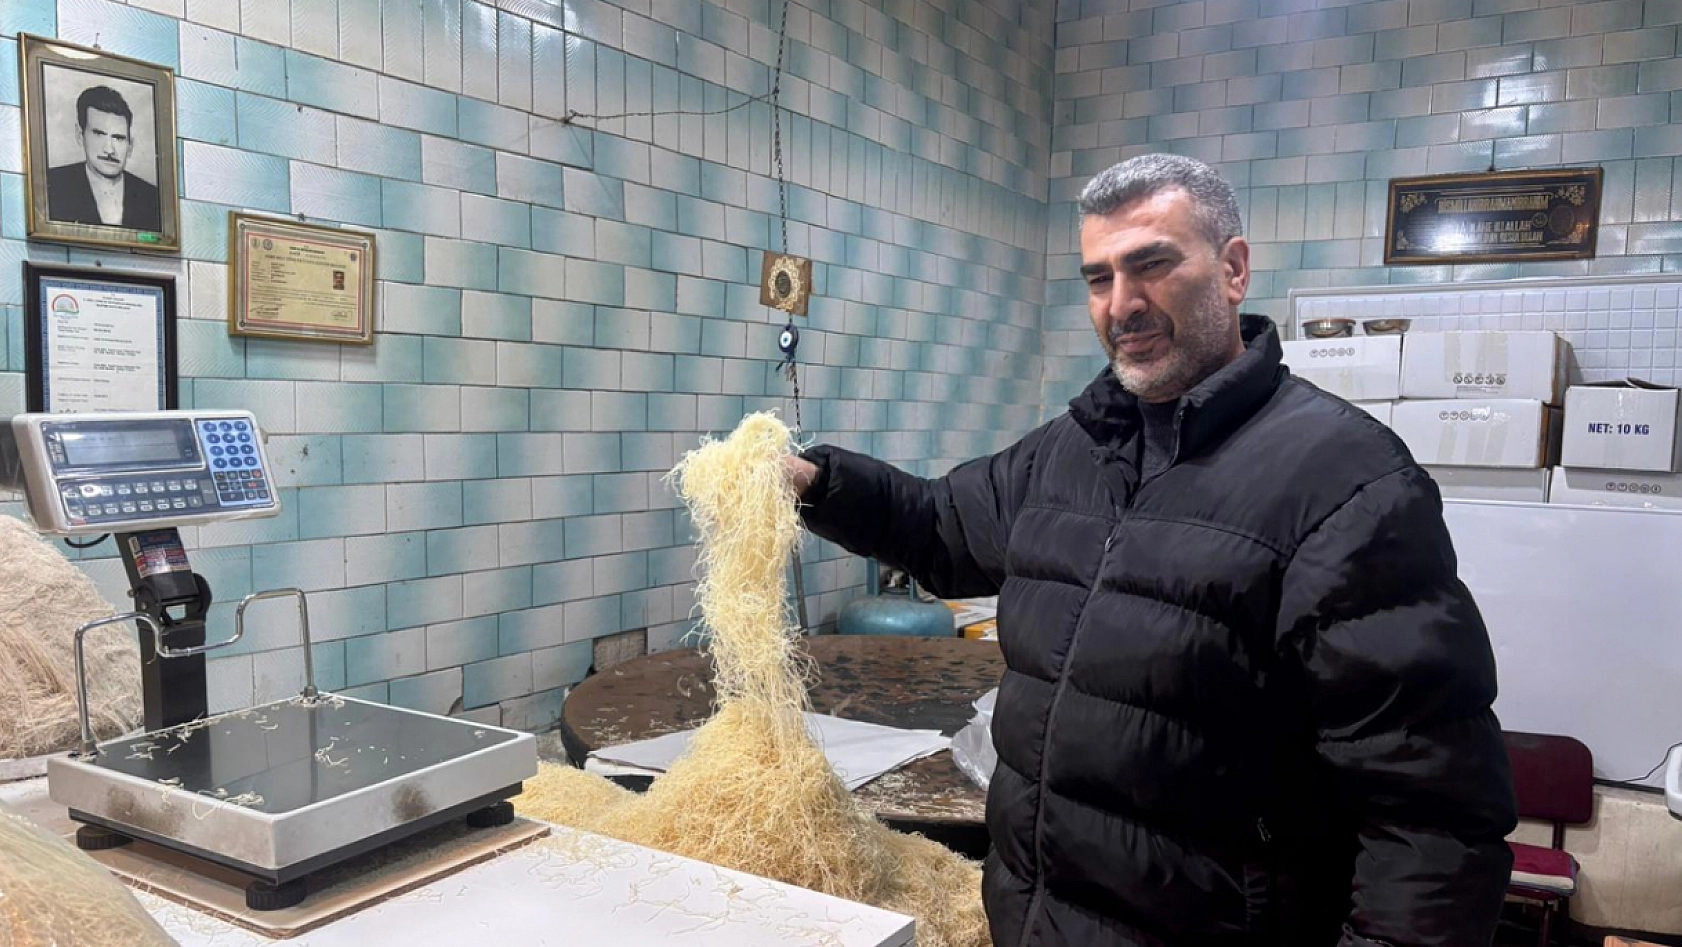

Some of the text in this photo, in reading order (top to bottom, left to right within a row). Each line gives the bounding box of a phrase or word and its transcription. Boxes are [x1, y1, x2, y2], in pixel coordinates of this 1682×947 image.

[1588, 422, 1650, 435] NET: 10 KG
